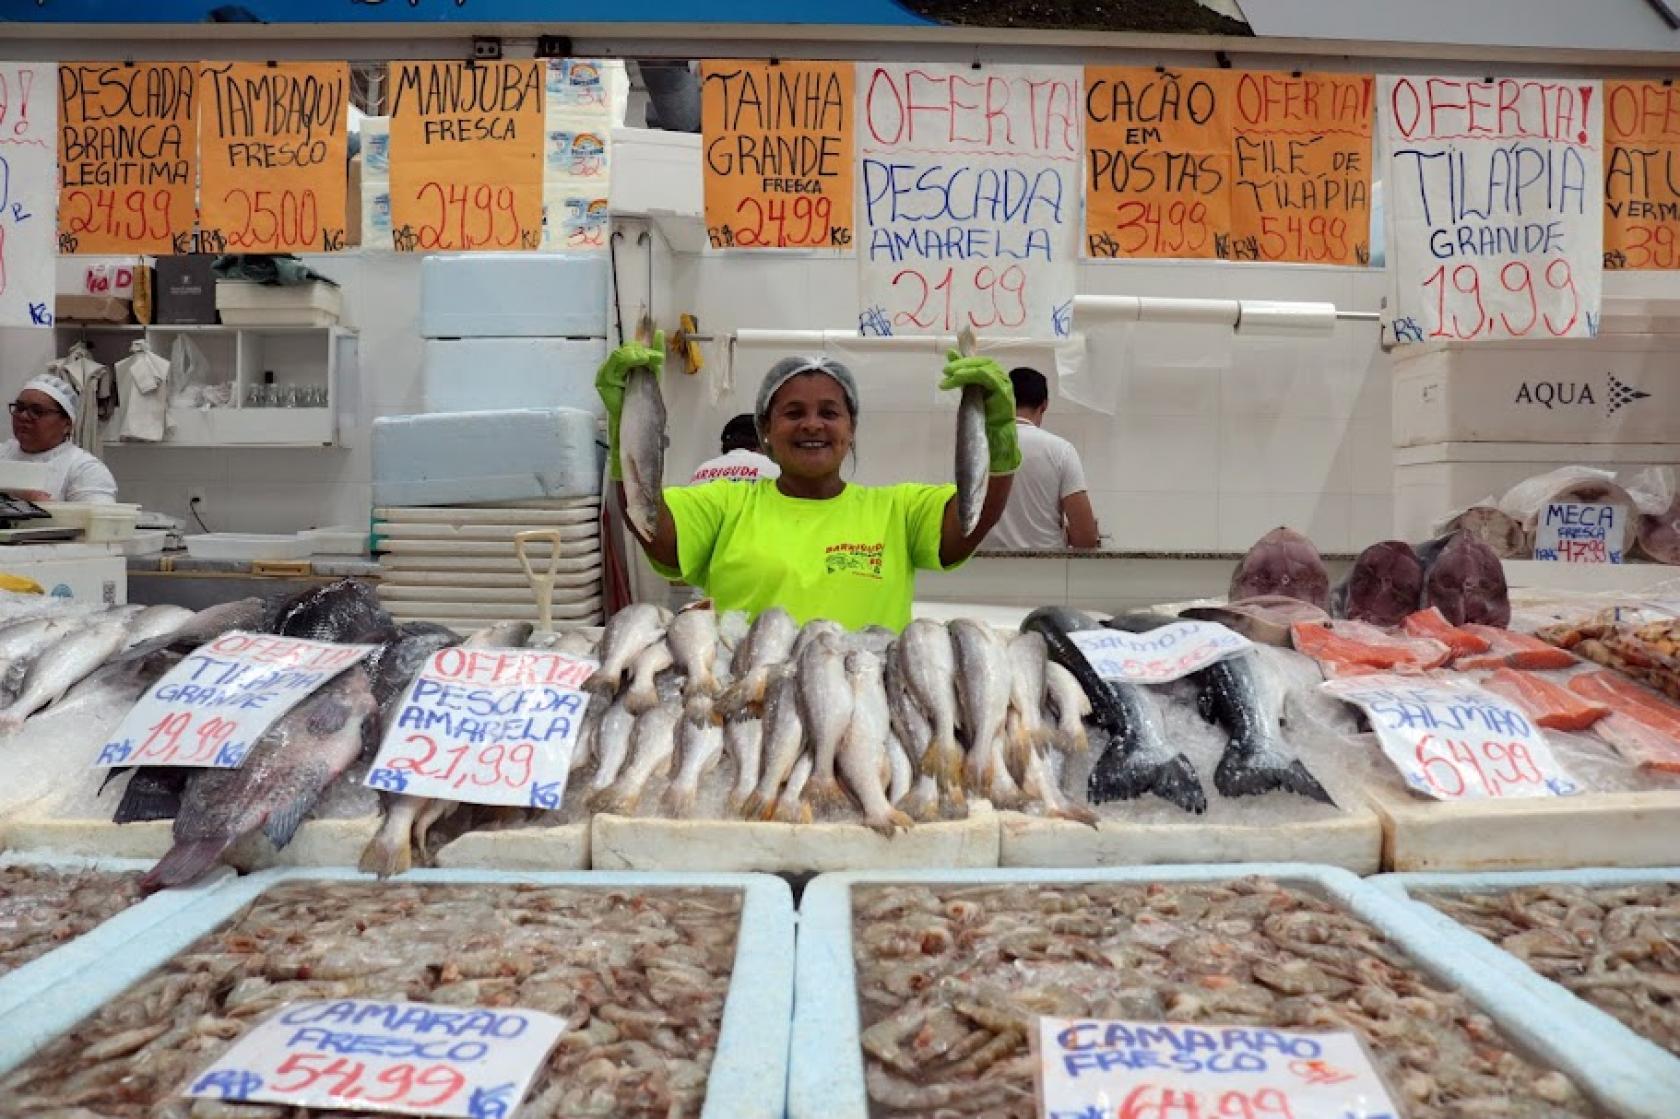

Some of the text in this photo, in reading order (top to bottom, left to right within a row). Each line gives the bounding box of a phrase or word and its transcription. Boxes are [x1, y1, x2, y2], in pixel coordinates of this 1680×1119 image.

[58, 65, 194, 122] PESCADA
[200, 63, 343, 146] TAMBAQUI
[392, 63, 542, 118] MANJUBA
[704, 65, 844, 132] TAINHA
[1236, 73, 1373, 130] OFERTA!
[1392, 78, 1594, 145] OFERTA!
[63, 124, 182, 162] BRANCA
[424, 117, 516, 144] FRESCA
[1126, 126, 1163, 144] EM
[62, 160, 189, 188] LEGITIMA
[228, 139, 327, 168] FRESCO
[707, 135, 842, 177] GRANDE
[1090, 149, 1223, 195] POSTAS
[1332, 151, 1362, 172] DE
[762, 178, 823, 194] FRESCA
[862, 158, 1063, 226] PESCADA
[68, 190, 172, 241] 24,99
[225, 187, 318, 250] 25,00
[1116, 200, 1208, 253] 34,99
[870, 226, 1052, 263] AMARELA
[1430, 221, 1565, 259] GRANDE
[1422, 258, 1580, 340] 19,99
[1515, 382, 1596, 409] AQUA
[1546, 504, 1613, 529] MECA
[412, 679, 584, 716] PESCADA
[129, 711, 237, 762] 19,99
[398, 705, 571, 743] AMARELA
[386, 735, 535, 788] 21,99
[1415, 734, 1543, 797] 64,99
[286, 1028, 490, 1061] FRESCO
[1063, 1050, 1268, 1077] FRESCO
[270, 1053, 467, 1108] 54,99
